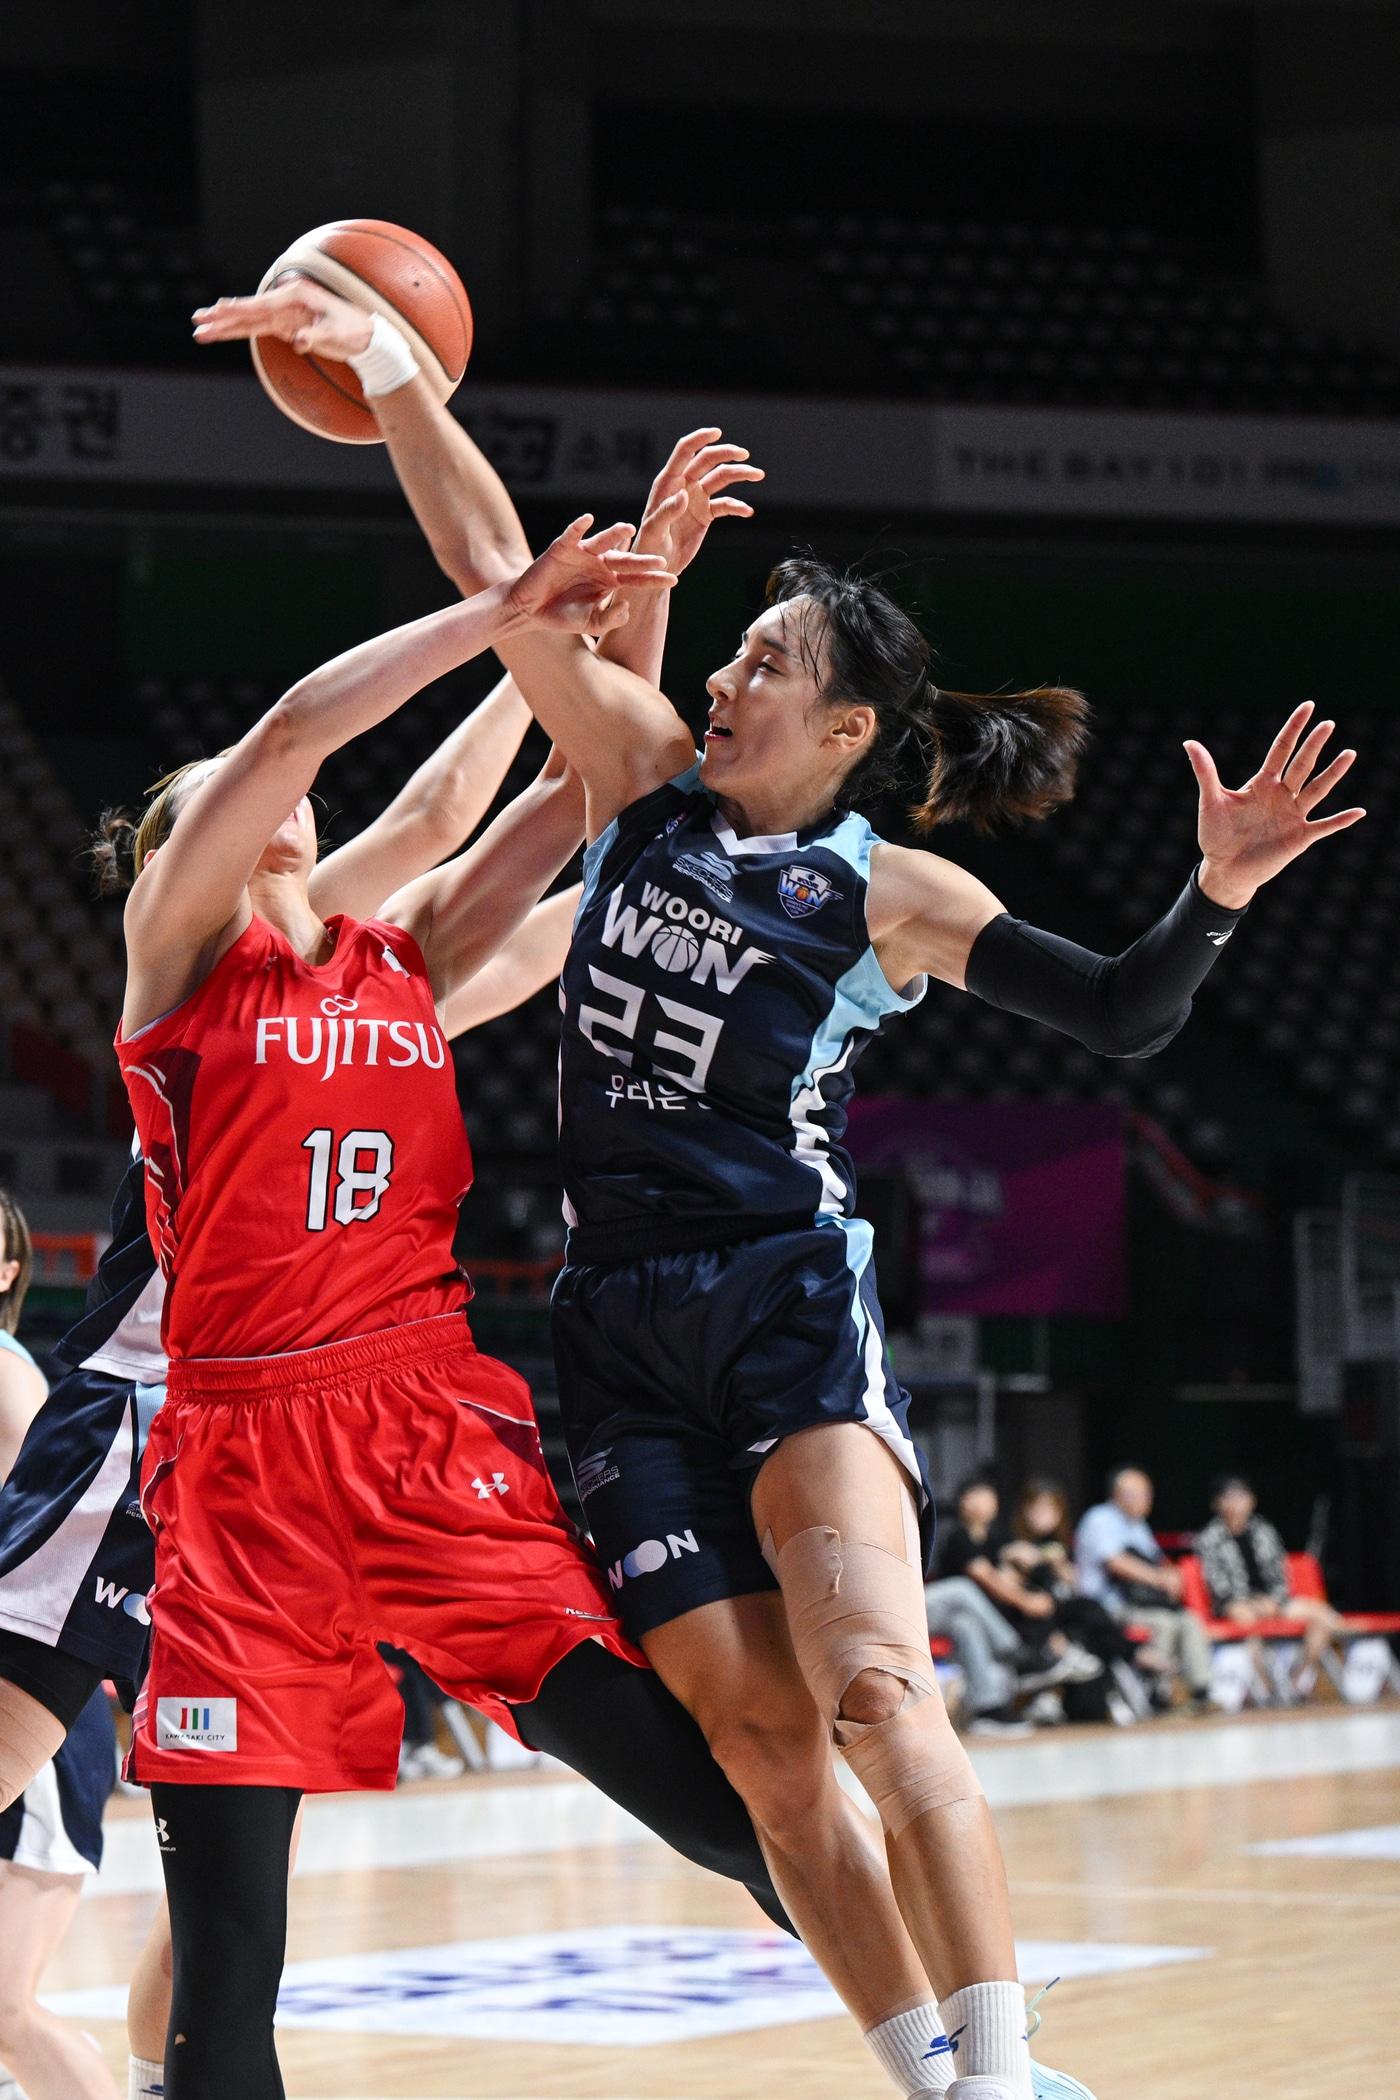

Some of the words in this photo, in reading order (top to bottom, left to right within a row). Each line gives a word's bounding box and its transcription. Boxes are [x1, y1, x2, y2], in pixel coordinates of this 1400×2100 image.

[601, 882, 777, 995] WON
[641, 881, 744, 946] WOORI
[254, 1016, 446, 1082] FUJITSU
[578, 964, 725, 1094] 23
[302, 1128, 395, 1232] 18
[206, 1733, 225, 1741] CITY
